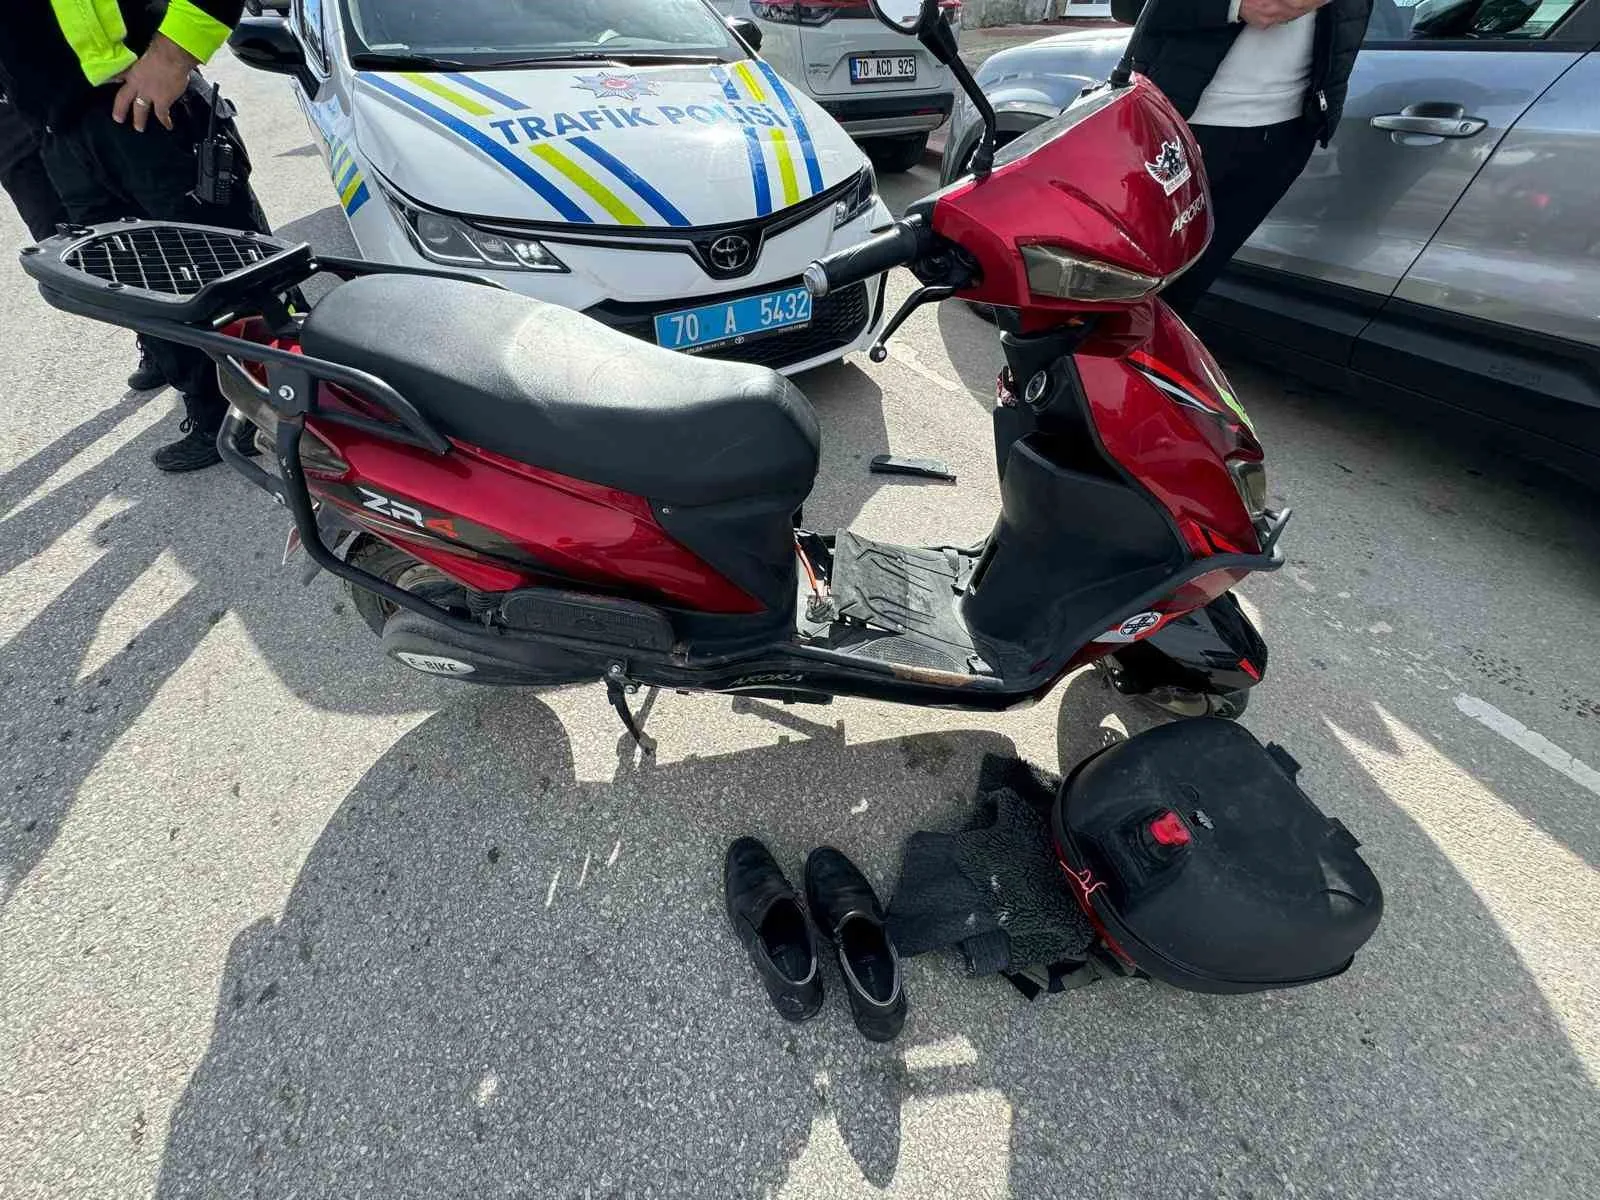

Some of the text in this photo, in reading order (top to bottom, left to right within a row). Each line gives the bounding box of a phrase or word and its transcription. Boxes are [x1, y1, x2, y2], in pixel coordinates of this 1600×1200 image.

[856, 60, 870, 77] 70
[897, 58, 914, 75] 925
[489, 104, 659, 145] TRAFİK
[670, 292, 809, 346] 70 A 5432
